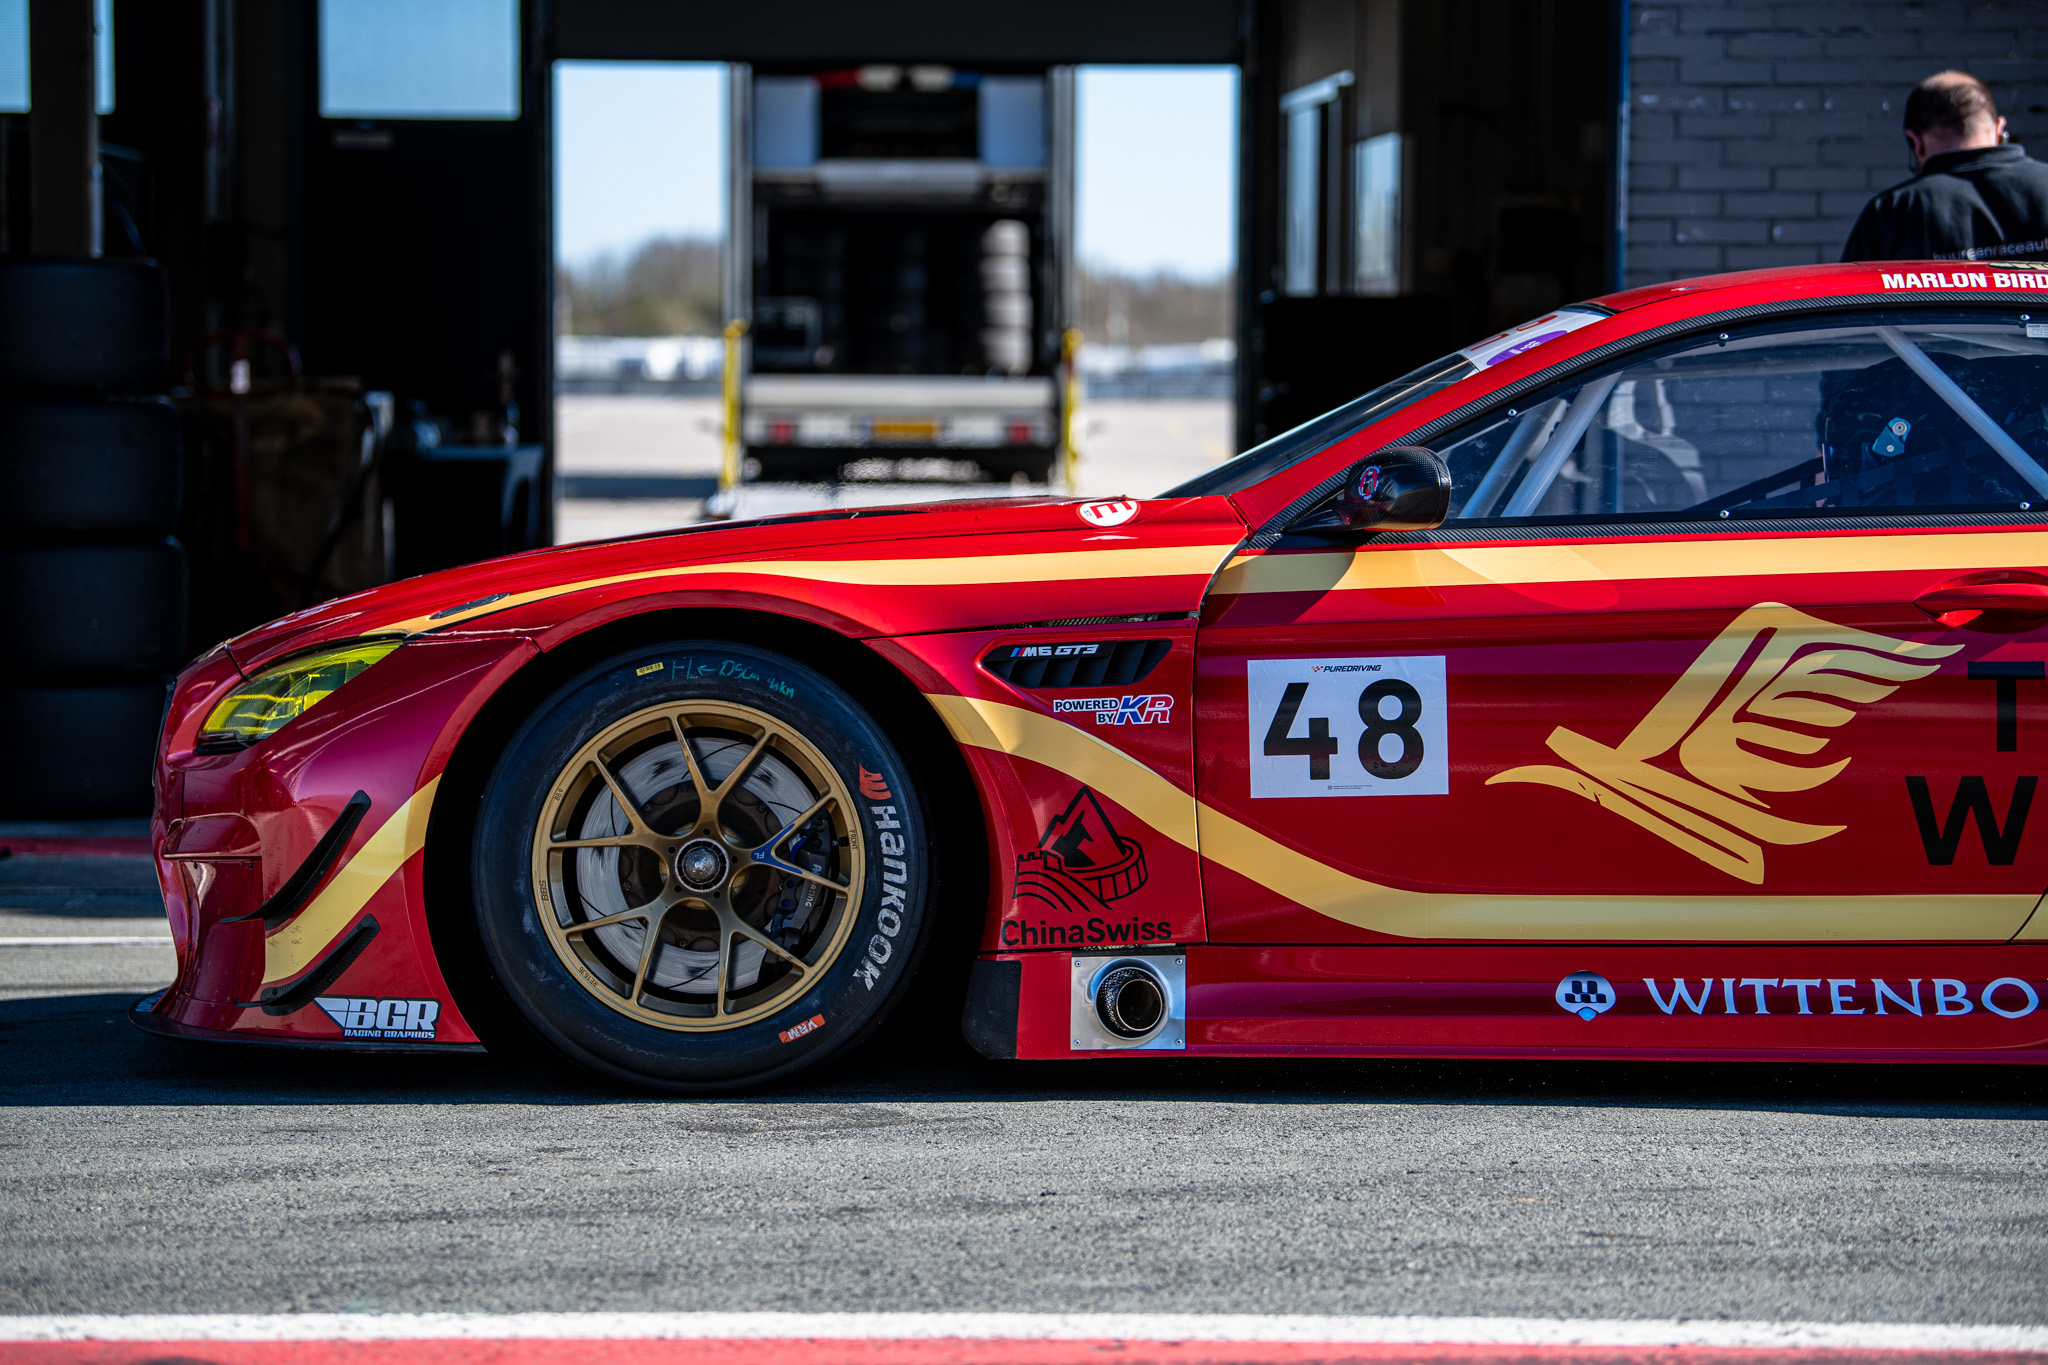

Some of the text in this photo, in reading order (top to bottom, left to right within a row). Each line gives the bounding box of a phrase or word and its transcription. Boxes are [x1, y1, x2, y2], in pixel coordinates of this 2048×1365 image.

[1881, 273, 2048, 289] MARLON BIRD
[1054, 644, 1099, 655] GT3
[1323, 664, 1382, 673] PUREDRIVING
[1055, 699, 1119, 713] POWERED
[1097, 694, 1174, 725] BY KR
[1968, 661, 2045, 752] T
[1264, 678, 1424, 780] 48
[1905, 775, 2039, 866] W
[849, 829, 859, 851] FRONT
[754, 851, 765, 860] FL
[538, 879, 550, 902] BBS
[853, 805, 908, 991] Hankook
[1001, 917, 1172, 946] ChinaSwiss
[1642, 977, 2040, 1019] WITTENBO
[345, 998, 439, 1031] BGR
[344, 1029, 435, 1039] RACING GRAPHICS
[787, 1019, 818, 1040] VRM
